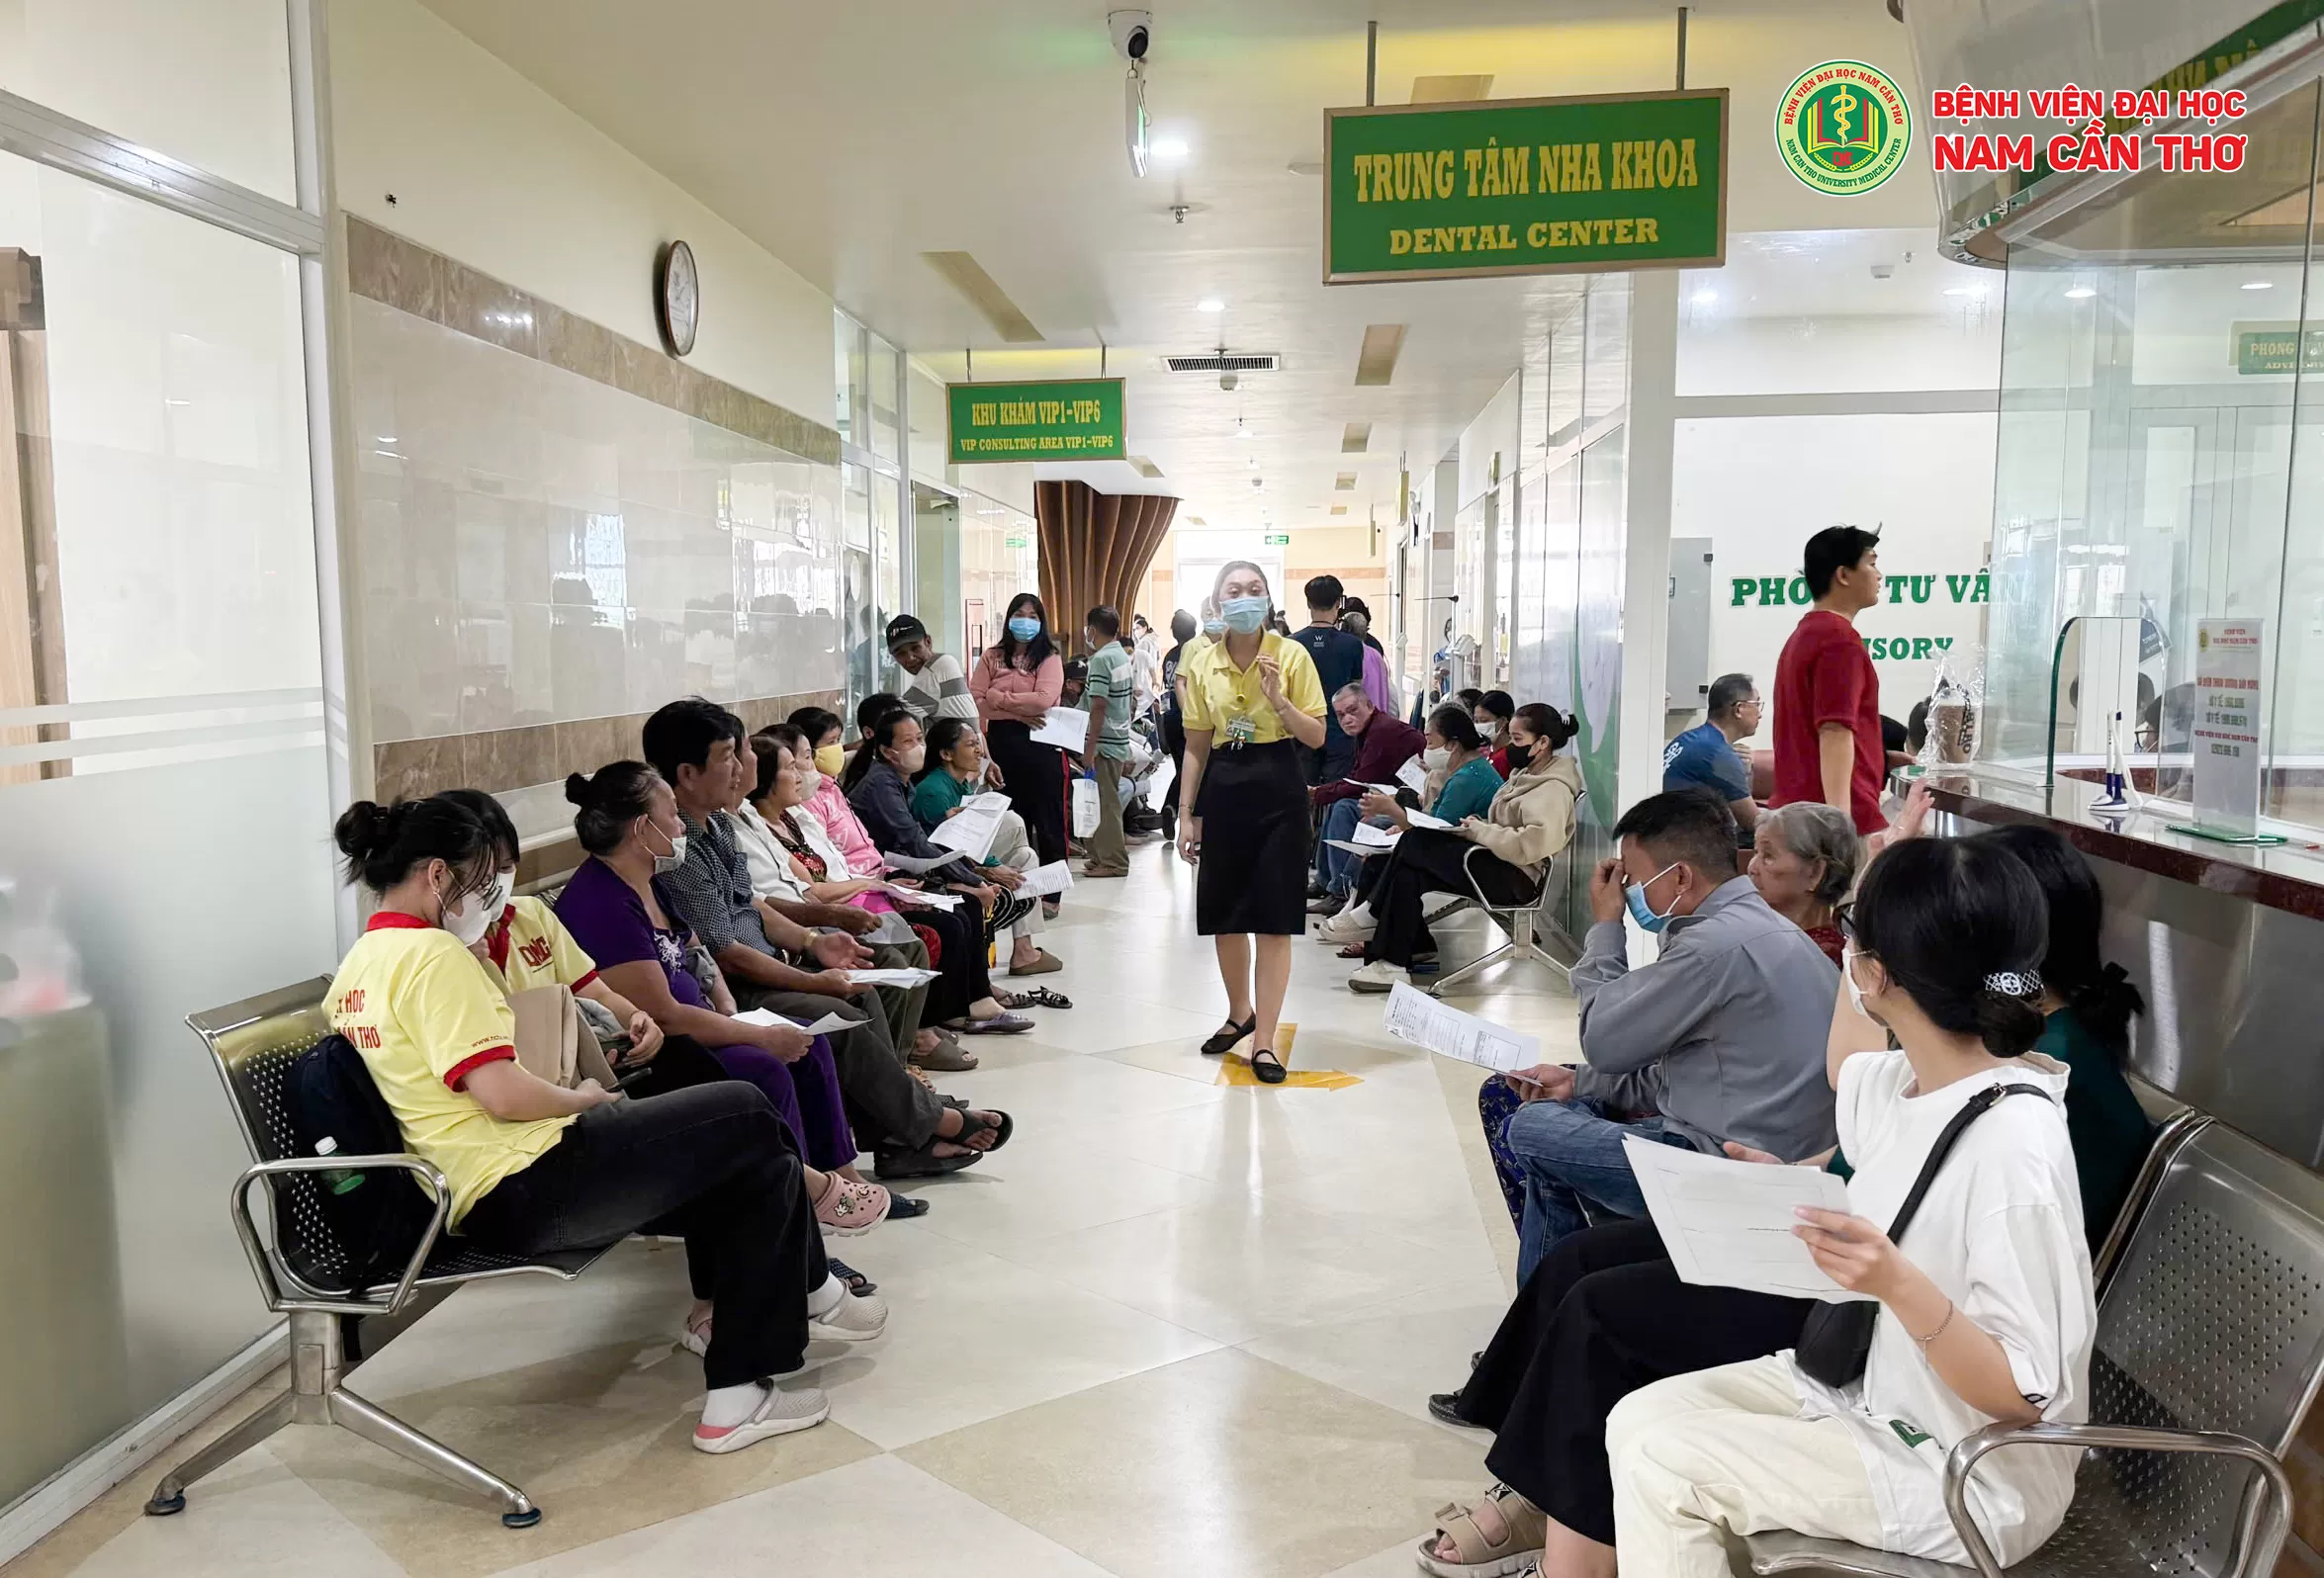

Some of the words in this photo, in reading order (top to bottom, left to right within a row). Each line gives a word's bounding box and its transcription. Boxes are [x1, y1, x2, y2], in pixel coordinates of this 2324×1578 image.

[1354, 150, 1455, 202] TRUNG
[1464, 136, 1530, 196] TÂM
[1538, 142, 1602, 193] NHA
[1611, 138, 1698, 190] KHOA
[1389, 224, 1517, 254] DENTAL
[1527, 218, 1658, 248] CENTER
[972, 403, 997, 426] KHU
[1000, 396, 1036, 425] KHÁM
[1038, 399, 1101, 424] VIP1-VIP6
[961, 438, 976, 451] VIP
[979, 437, 1037, 451] CONSULTING
[1039, 437, 1063, 450] AREA
[1066, 435, 1114, 449] VIP1-VIP6
[1732, 570, 1814, 606] PHÒ
[1885, 575, 1936, 604] TƯ
